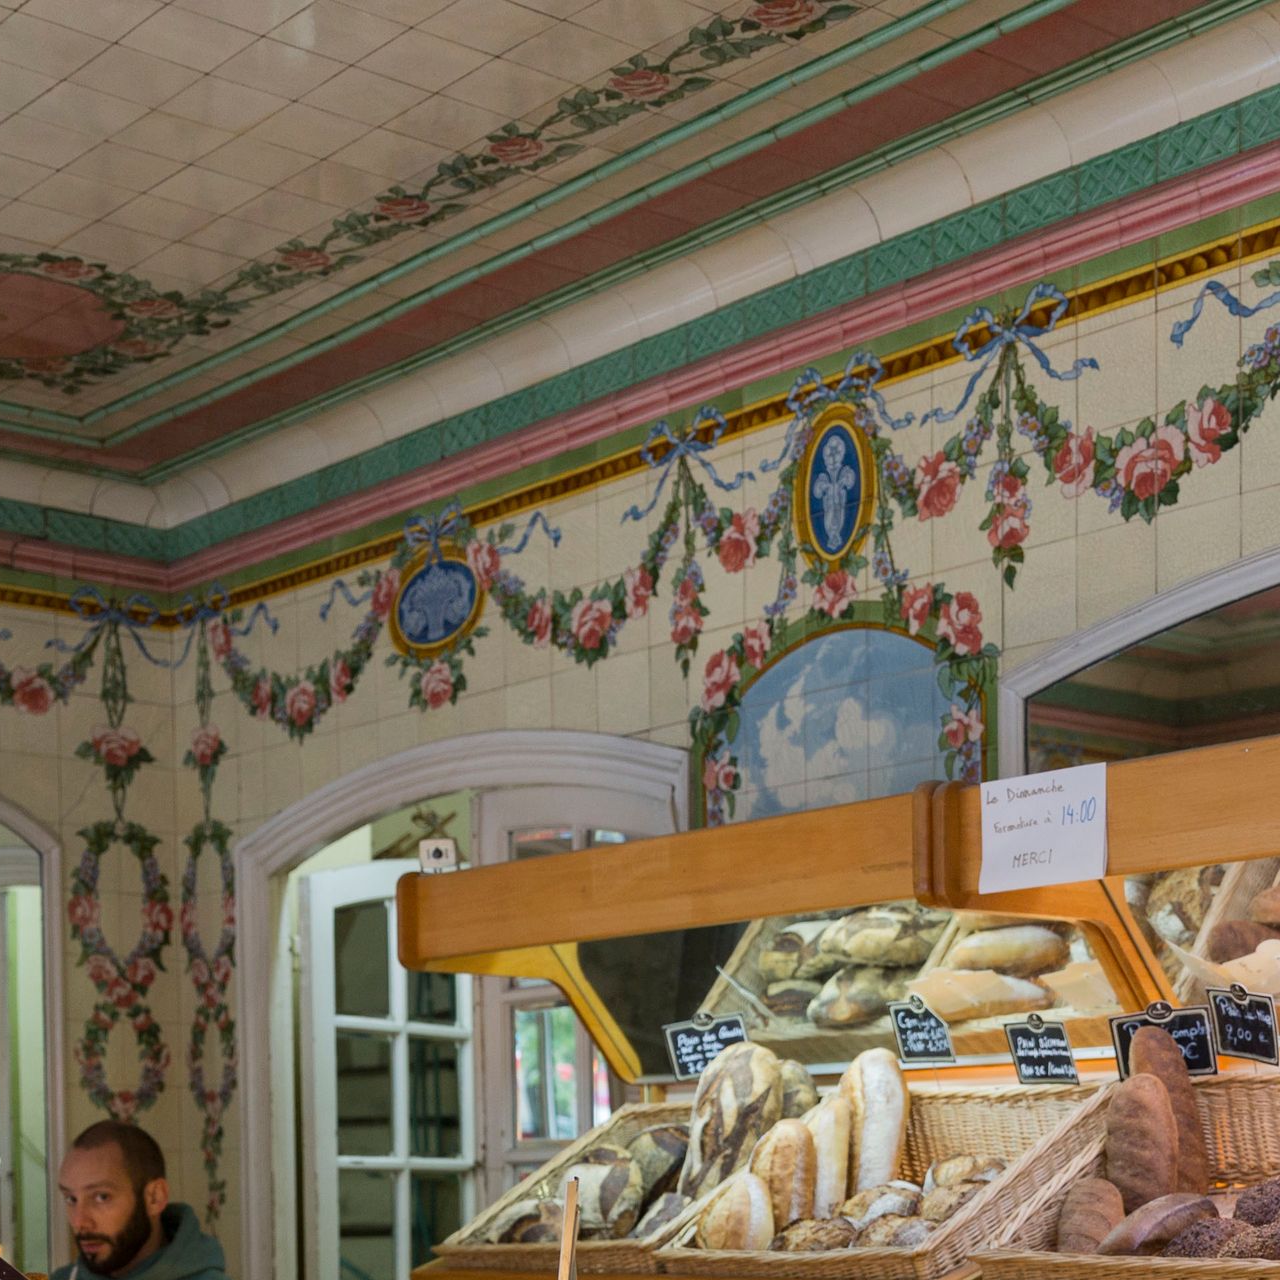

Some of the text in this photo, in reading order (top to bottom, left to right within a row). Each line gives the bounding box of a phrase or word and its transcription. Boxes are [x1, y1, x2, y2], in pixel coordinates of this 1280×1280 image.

[986, 778, 1064, 805] Le Dimanche
[1061, 796, 1096, 825] 14:00
[1011, 848, 1052, 868] MERCI
